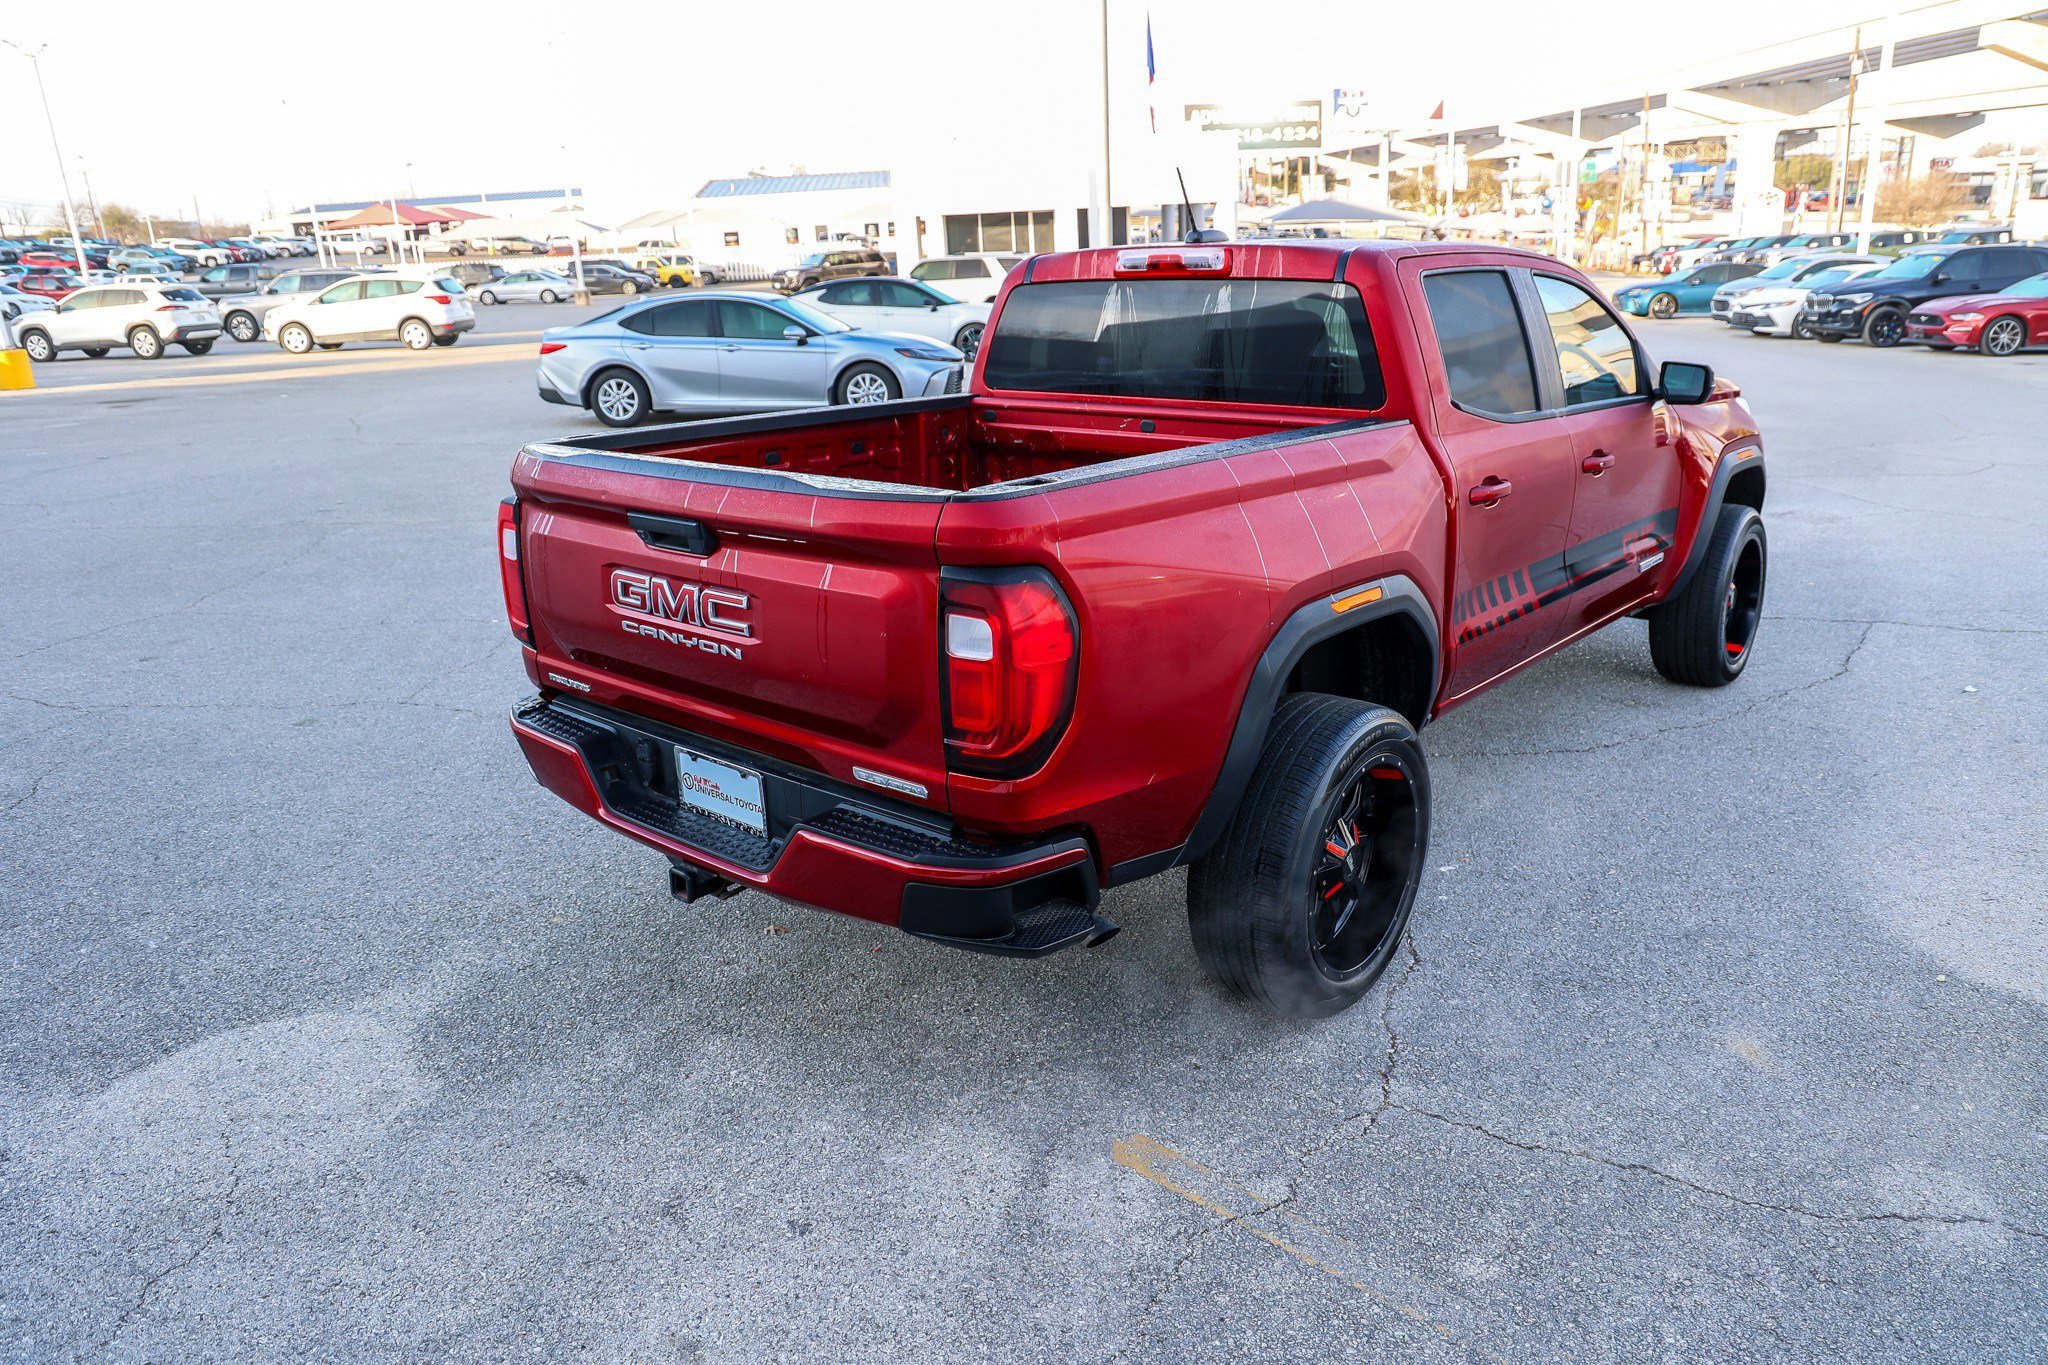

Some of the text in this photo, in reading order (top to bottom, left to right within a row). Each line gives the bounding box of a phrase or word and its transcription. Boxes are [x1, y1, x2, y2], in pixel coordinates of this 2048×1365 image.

[611, 569, 751, 637] GMC
[621, 620, 743, 660] CANYON
[694, 783, 762, 814] UNIVERSAL TOYOTA
